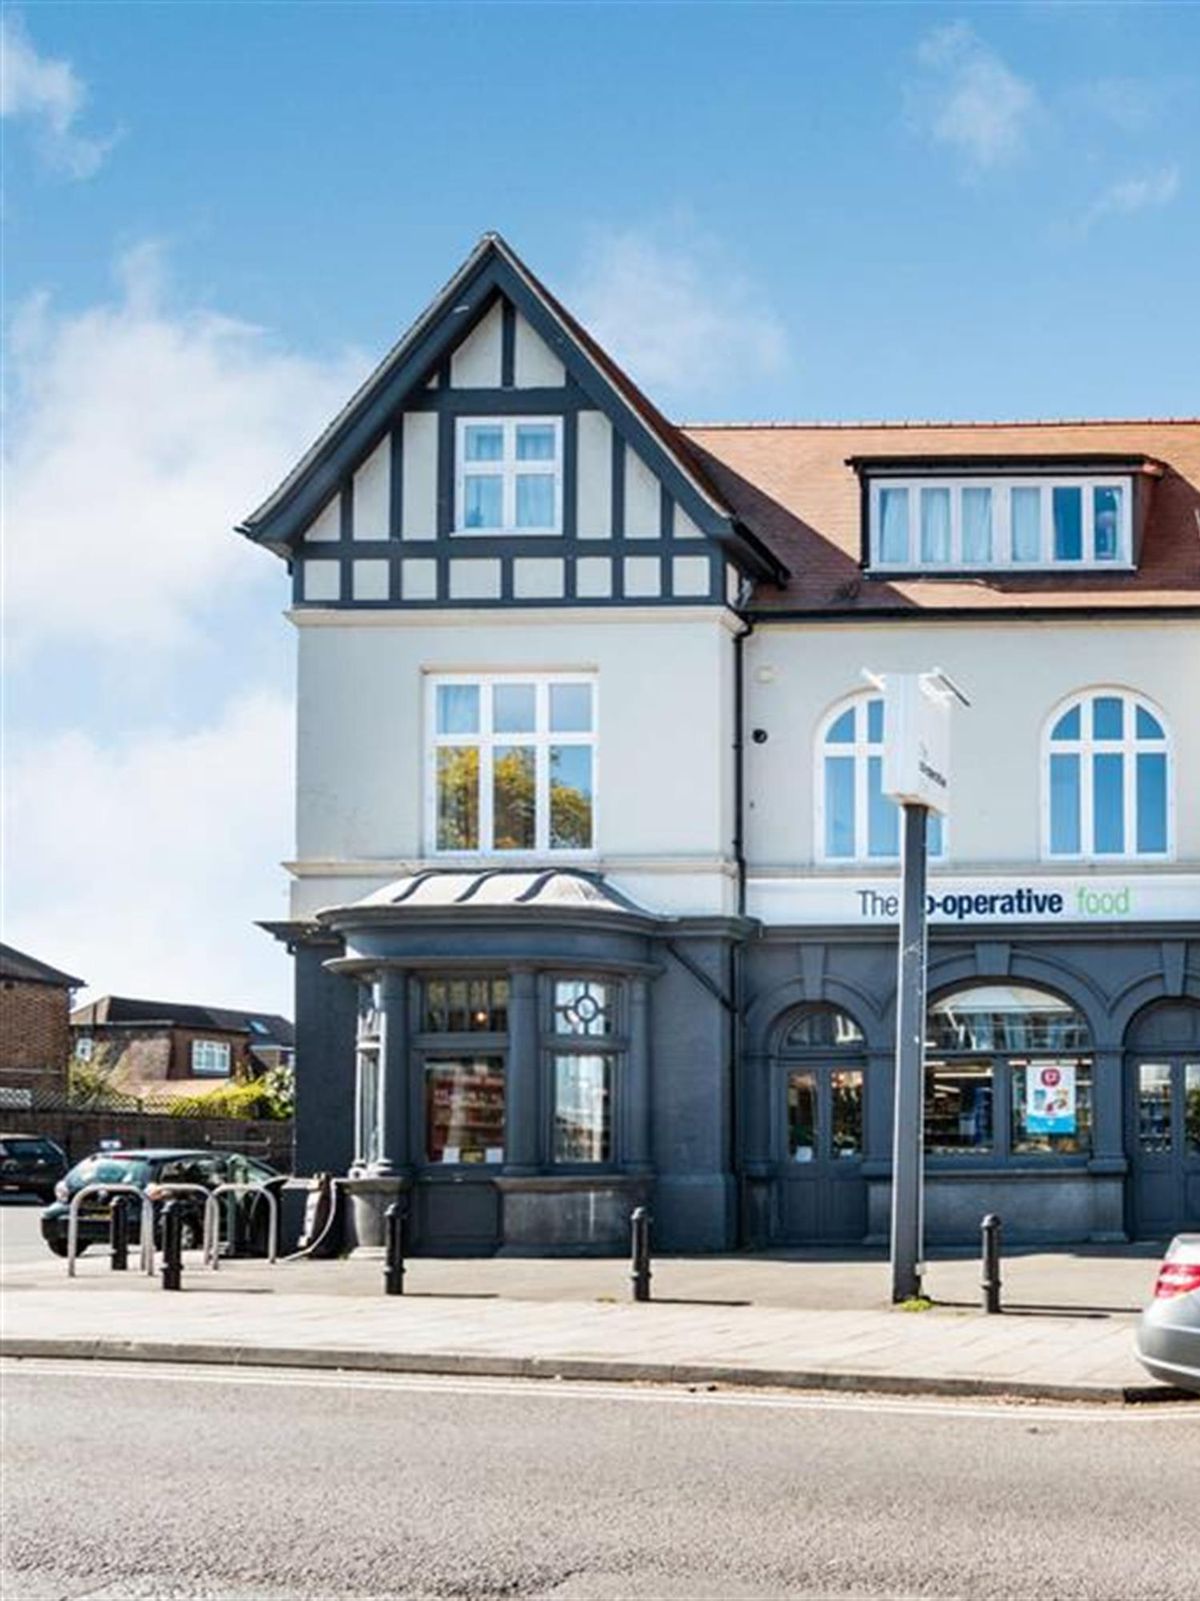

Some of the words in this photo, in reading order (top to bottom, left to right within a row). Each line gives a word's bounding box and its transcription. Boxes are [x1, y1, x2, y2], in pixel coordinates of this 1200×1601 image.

[856, 890, 899, 916] The
[926, 888, 1063, 919] o-operative
[1077, 887, 1130, 914] food
